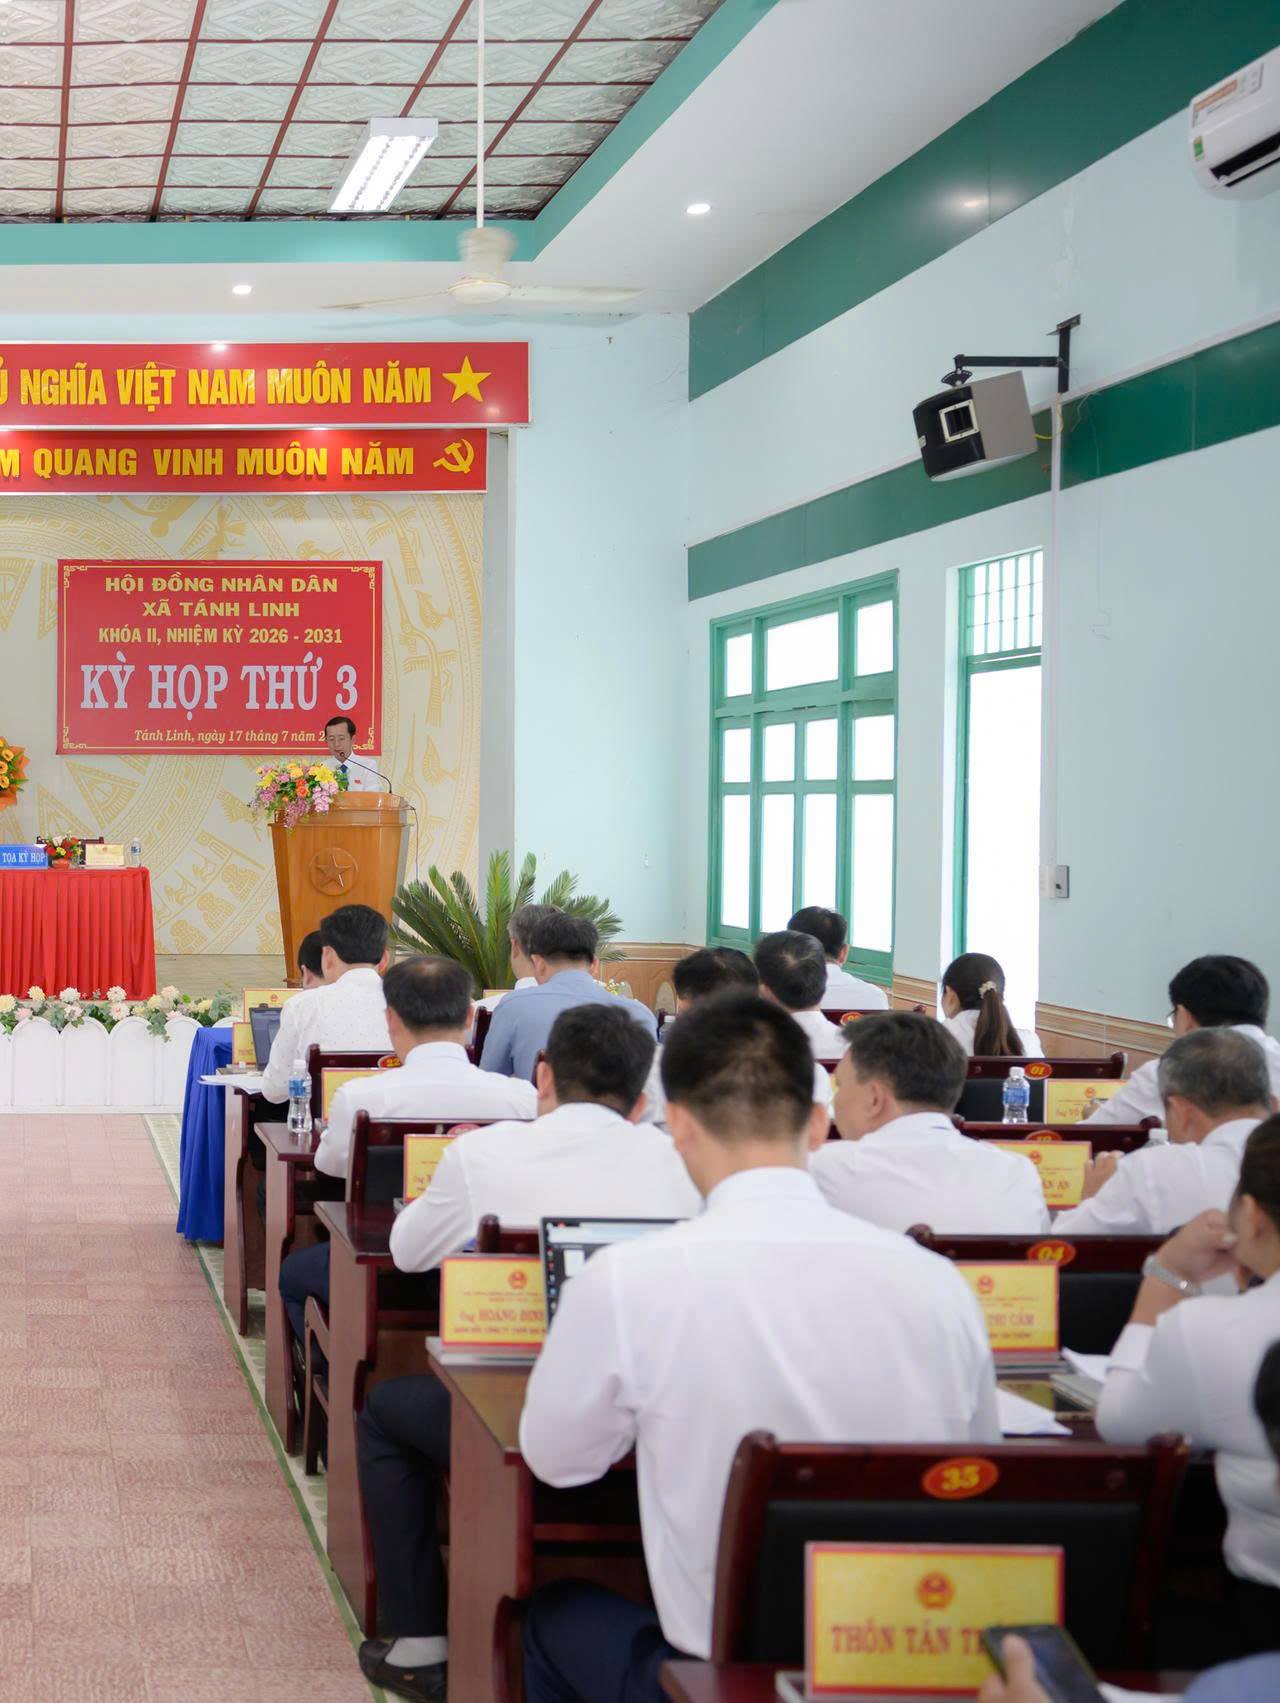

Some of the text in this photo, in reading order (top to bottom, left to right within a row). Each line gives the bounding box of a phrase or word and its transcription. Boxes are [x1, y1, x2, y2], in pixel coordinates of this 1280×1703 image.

[20, 361, 107, 406] NGHĨA
[117, 360, 177, 413] VIỆT
[188, 367, 258, 405] NAM
[265, 360, 352, 405] MUÔN
[363, 360, 432, 404] NĂM
[33, 448, 137, 479] QUANG
[153, 448, 223, 477] VINH
[236, 440, 328, 476] MUÔN
[342, 442, 414, 476] NĂM
[106, 571, 338, 595] HỘI ĐỒNG NHÂN DÂN
[143, 599, 300, 617] XÃ TÁNH LINH
[98, 625, 141, 643] KHÓA
[147, 628, 161, 646] II,
[166, 625, 218, 645] NHIỆM
[223, 625, 243, 643] KỲ
[249, 629, 289, 643] 2026
[303, 629, 342, 643] 2031
[80, 650, 358, 721] KỲ HỌP THỨ 3
[134, 729, 163, 741] Tánh
[166, 730, 195, 743] Linh,
[198, 730, 226, 744] ngày
[229, 731, 242, 741] 17
[245, 730, 278, 744] tháng
[281, 731, 288, 741] 7
[291, 731, 316, 741] năm
[1030, 1065, 1046, 1075] 01
